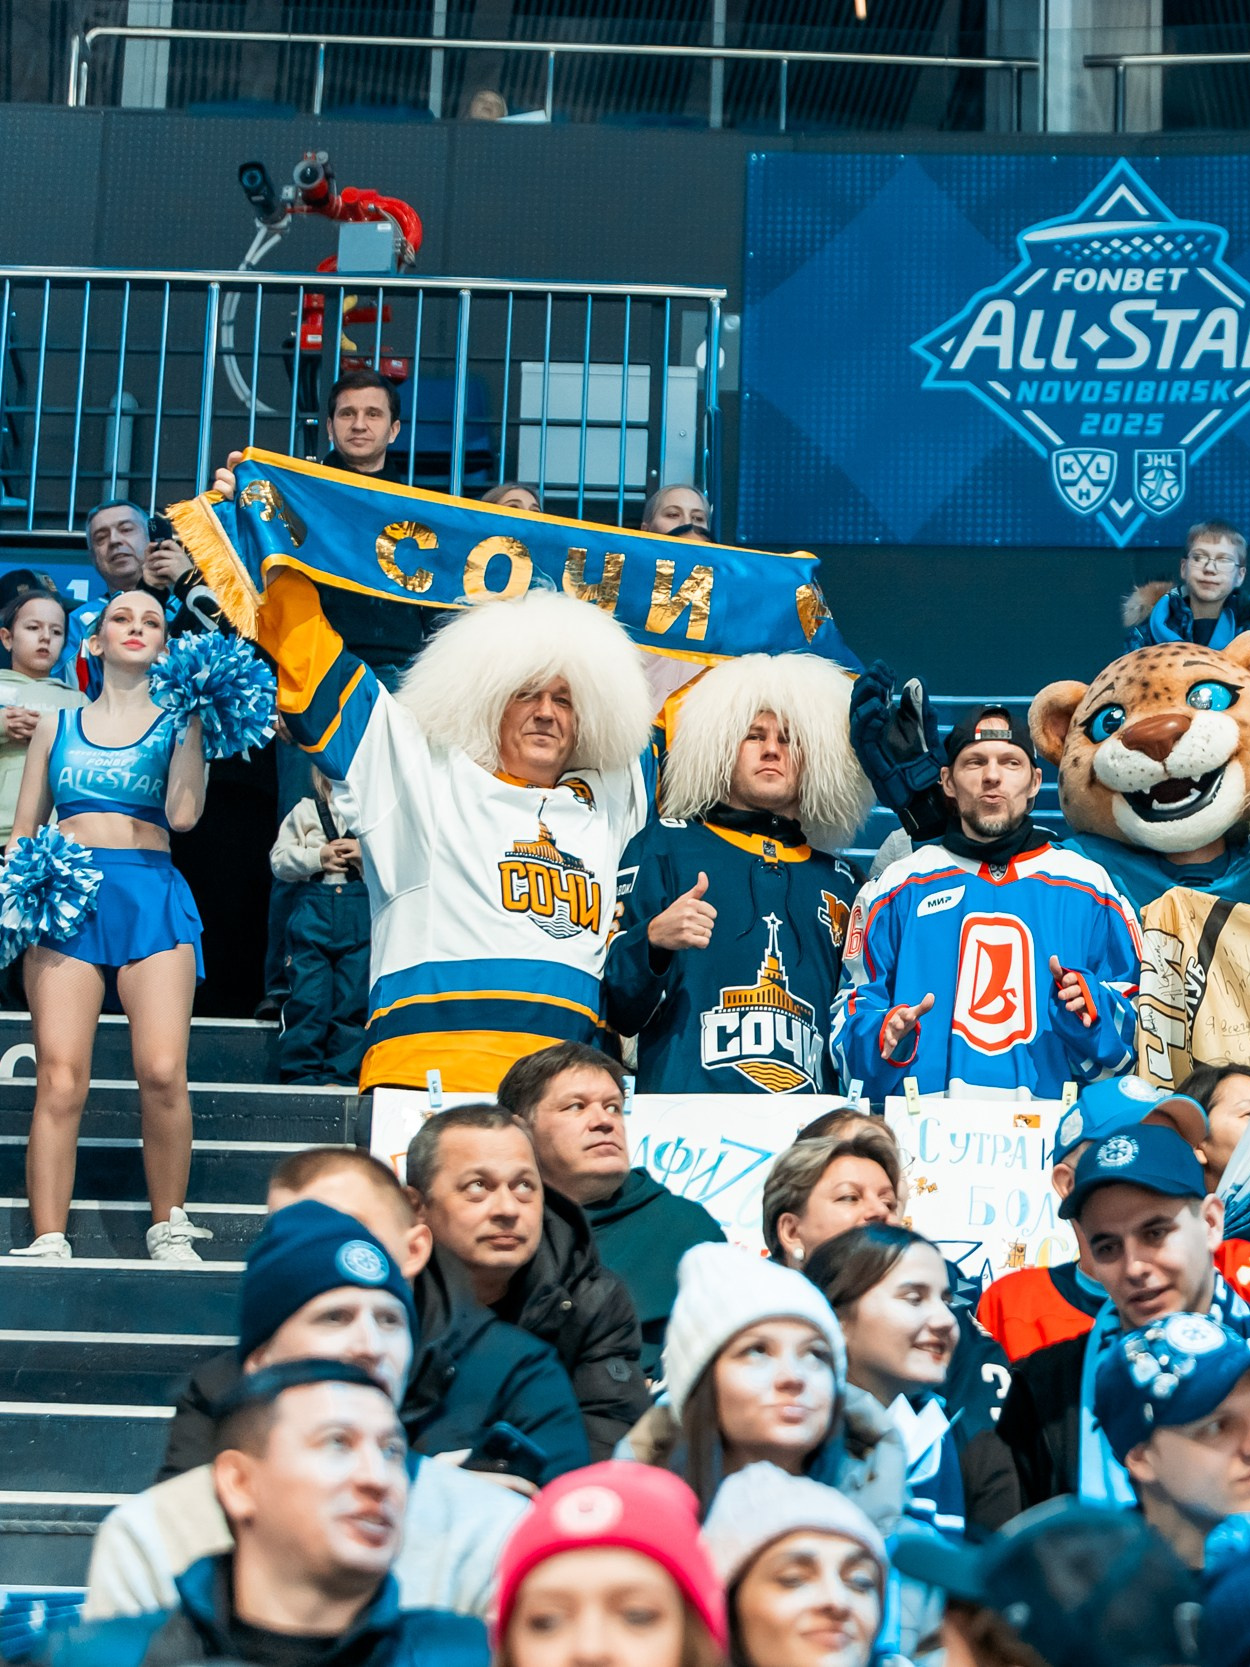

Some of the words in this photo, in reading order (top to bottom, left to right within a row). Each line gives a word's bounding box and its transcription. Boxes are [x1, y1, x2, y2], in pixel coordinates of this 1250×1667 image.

[1052, 267, 1188, 292] FONBET
[1016, 379, 1233, 403] NOVOSIBIRSK
[1079, 412, 1164, 436] 2025
[1143, 453, 1176, 466] JHL
[375, 520, 714, 641] СОЧИ
[498, 861, 602, 935] СОЧИ
[927, 896, 952, 908] МИР
[702, 1012, 824, 1093] СОЧИ
